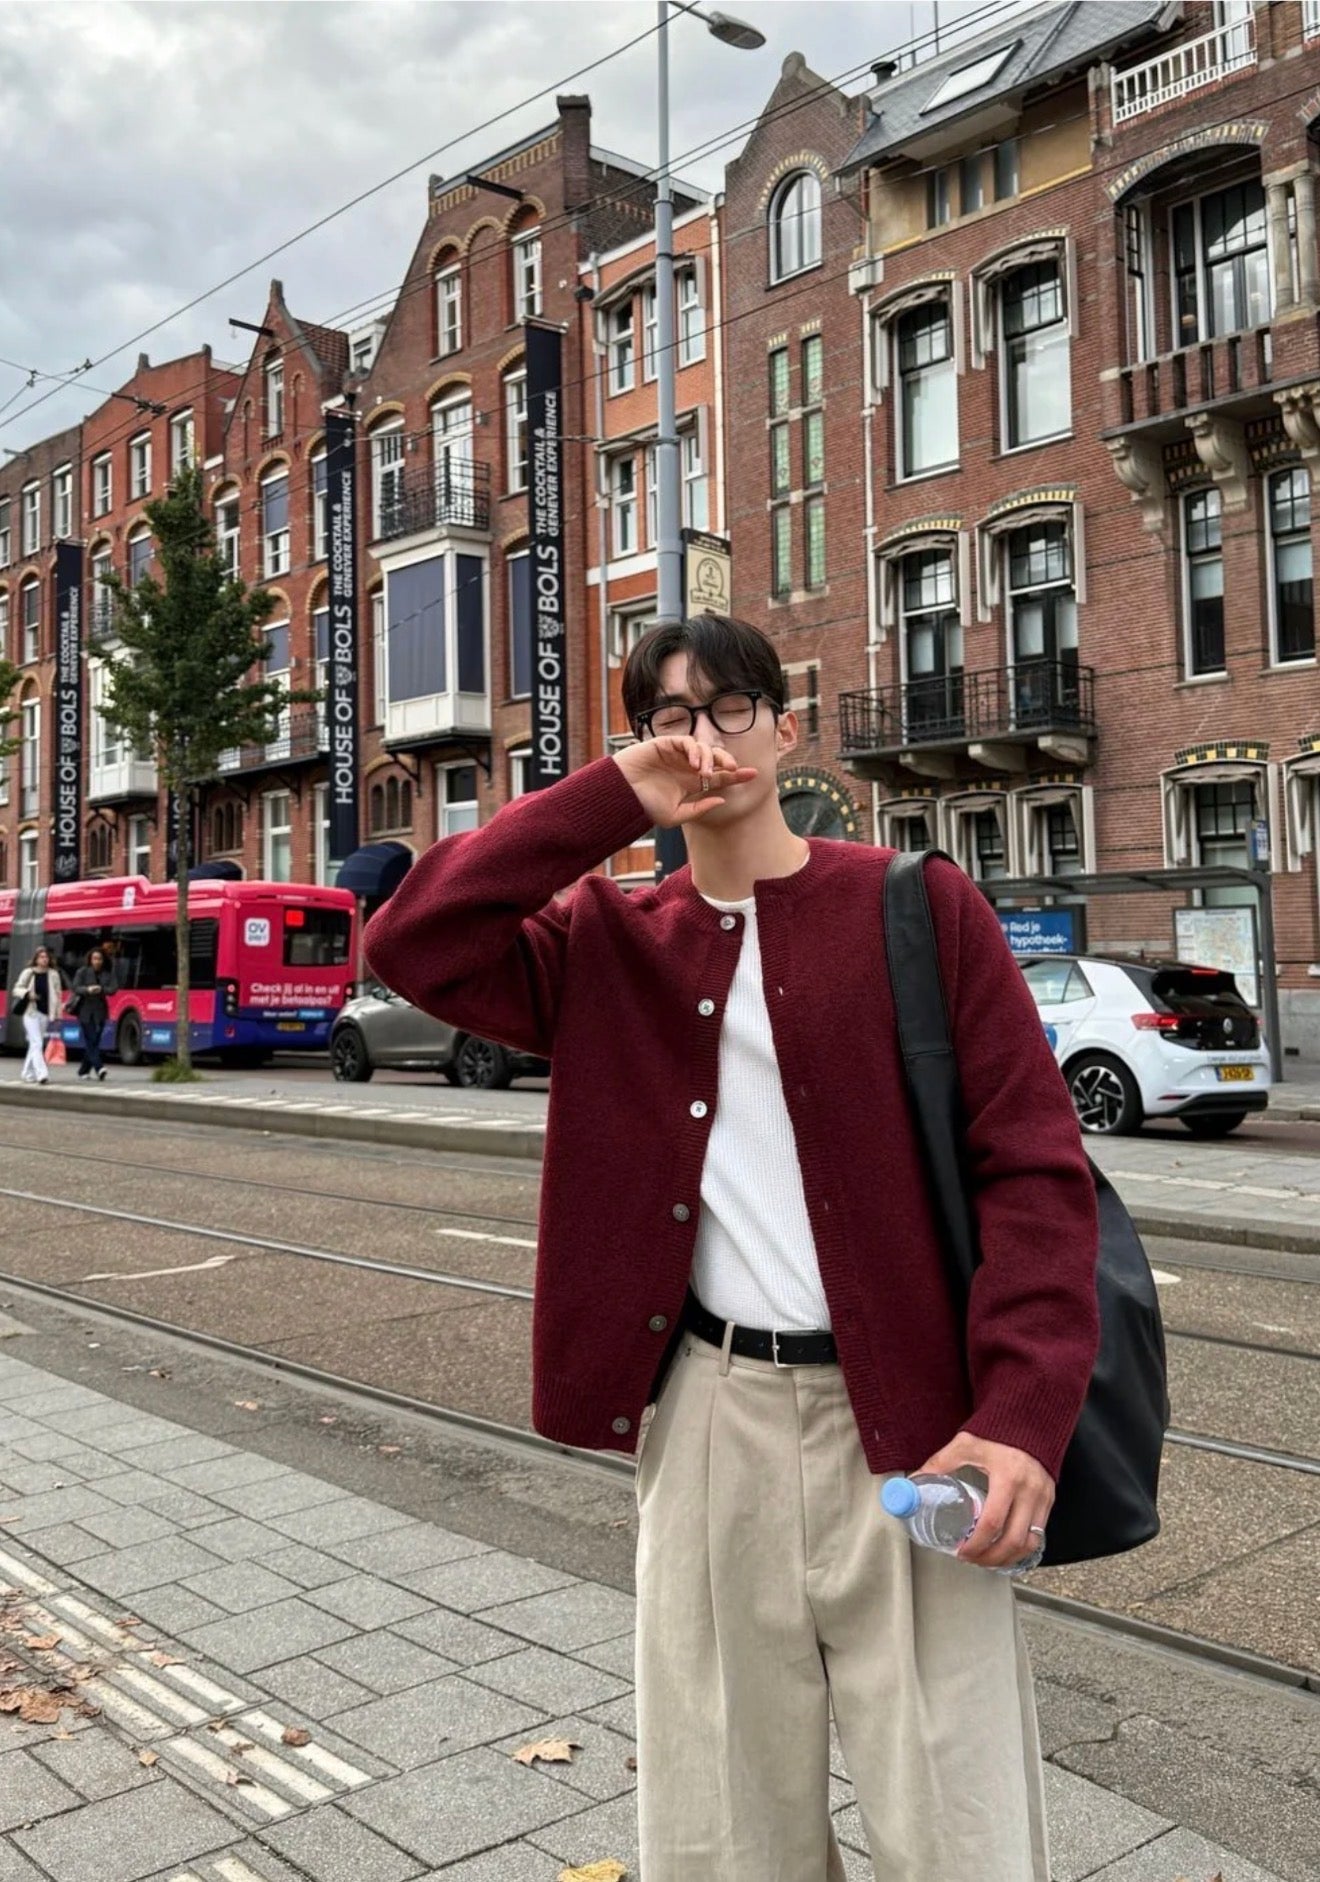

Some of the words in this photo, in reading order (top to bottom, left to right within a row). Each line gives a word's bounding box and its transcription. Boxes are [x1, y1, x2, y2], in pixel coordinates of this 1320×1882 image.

[534, 427, 545, 438] &
[545, 391, 558, 474] EXPERIENCE
[535, 440, 546, 507] COCKTAIL
[332, 503, 342, 513] &
[342, 471, 352, 543] EXPERIENCE
[536, 509, 547, 535] THE
[547, 475, 559, 537] GENEVER
[332, 515, 342, 572] COCKTAIL
[333, 574, 343, 596] THE
[343, 543, 353, 598] GENEVER
[537, 544, 560, 613] BOLS
[334, 605, 352, 663] BOLS
[538, 642, 561, 681] OF
[60, 689, 77, 735] BOLS
[335, 687, 353, 722] OF
[538, 684, 562, 774] HOUSE
[60, 755, 77, 783] OF
[335, 725, 354, 804] HOUSE
[59, 785, 77, 847] HOUSE
[248, 923, 267, 933] OV
[1010, 921, 1030, 933] Red
[1030, 920, 1041, 935] je
[1010, 933, 1068, 947] hypotheek-
[250, 983, 281, 994] Check
